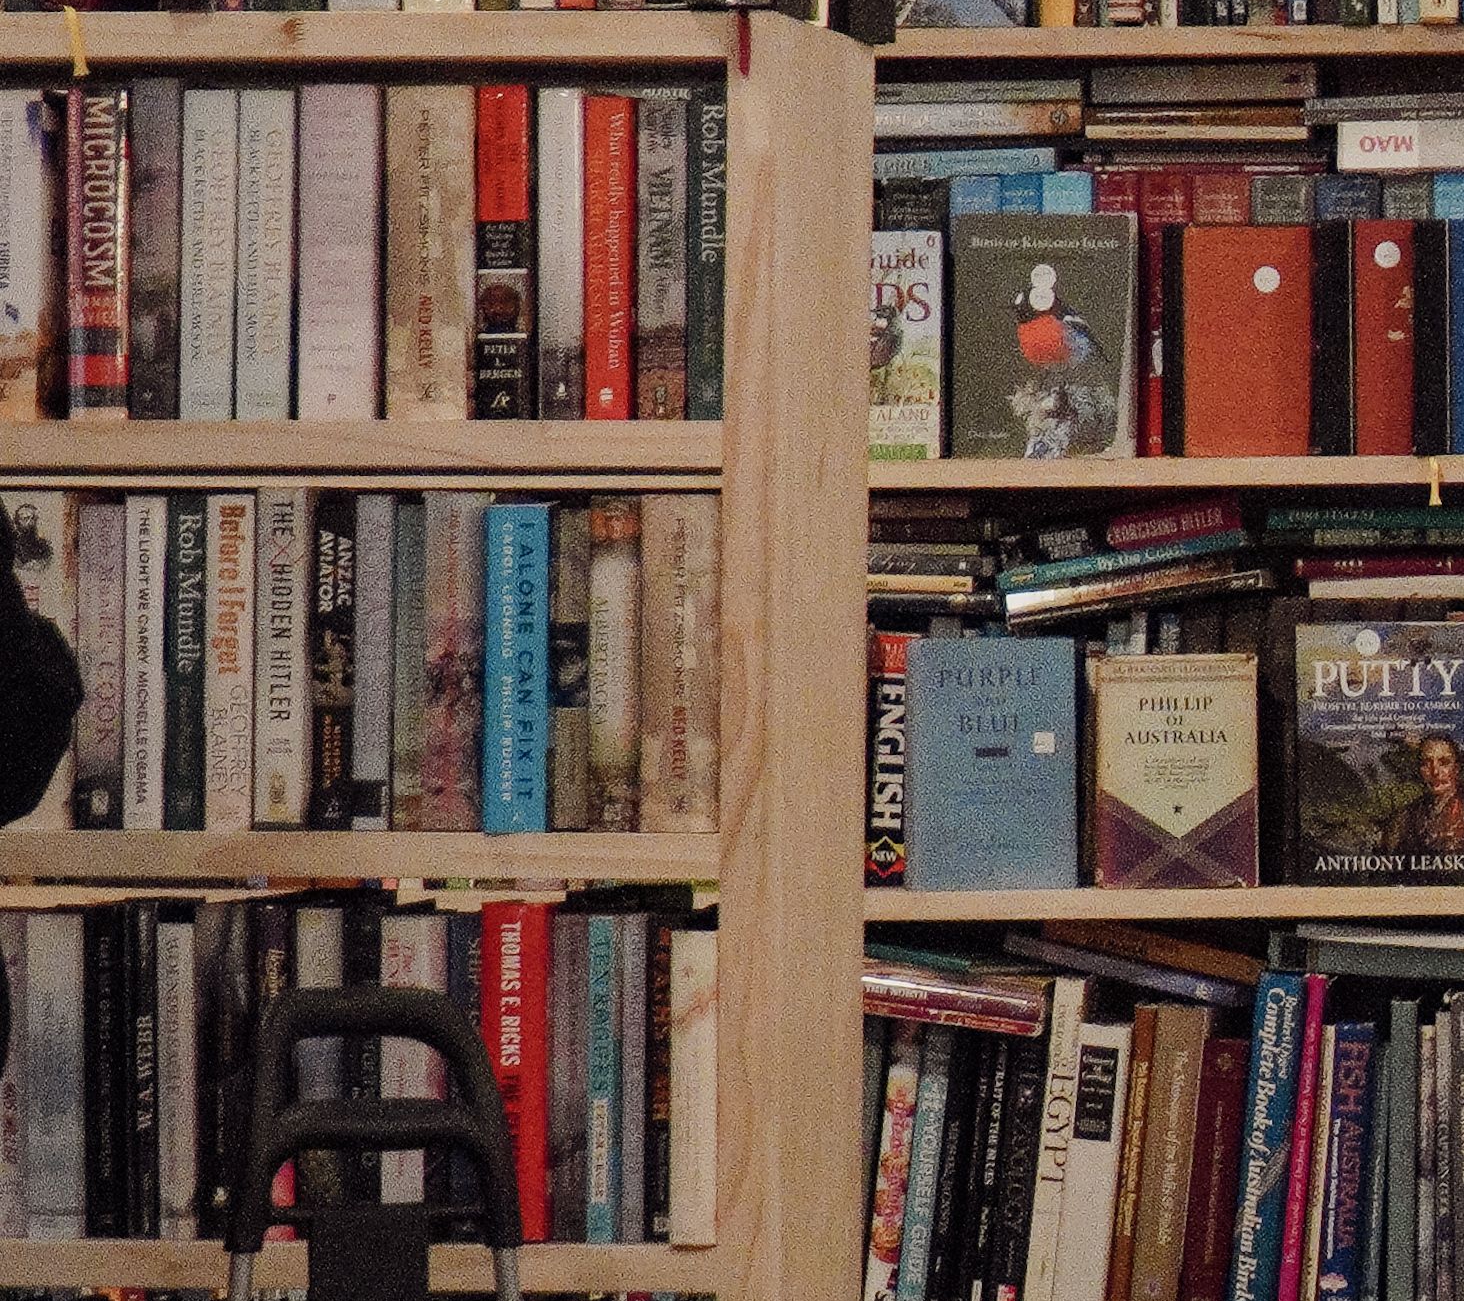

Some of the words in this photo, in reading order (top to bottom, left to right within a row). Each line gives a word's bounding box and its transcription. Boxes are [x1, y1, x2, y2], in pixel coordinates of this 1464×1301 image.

[82, 96, 116, 288] MICROCOSM
[178, 514, 201, 563] Rob
[220, 505, 248, 580] Before
[272, 502, 293, 536] THE
[218, 586, 247, 594] I
[271, 564, 292, 640] HIDDEN
[316, 530, 335, 613] AVIATOR
[335, 536, 353, 607] ANZAC
[176, 570, 200, 673] Mundle
[212, 598, 244, 675] Forget
[269, 649, 290, 721] HITLER
[1139, 696, 1214, 713] PHILLIP
[1313, 658, 1463, 698] PUTTY
[873, 678, 905, 831] ENGLISH
[1124, 728, 1228, 745] AUSTRALIA
[1315, 854, 1403, 873] ANTHONY
[498, 922, 520, 991] THOMAS
[500, 996, 520, 1010] E.
[500, 1013, 521, 1066] RICKS
